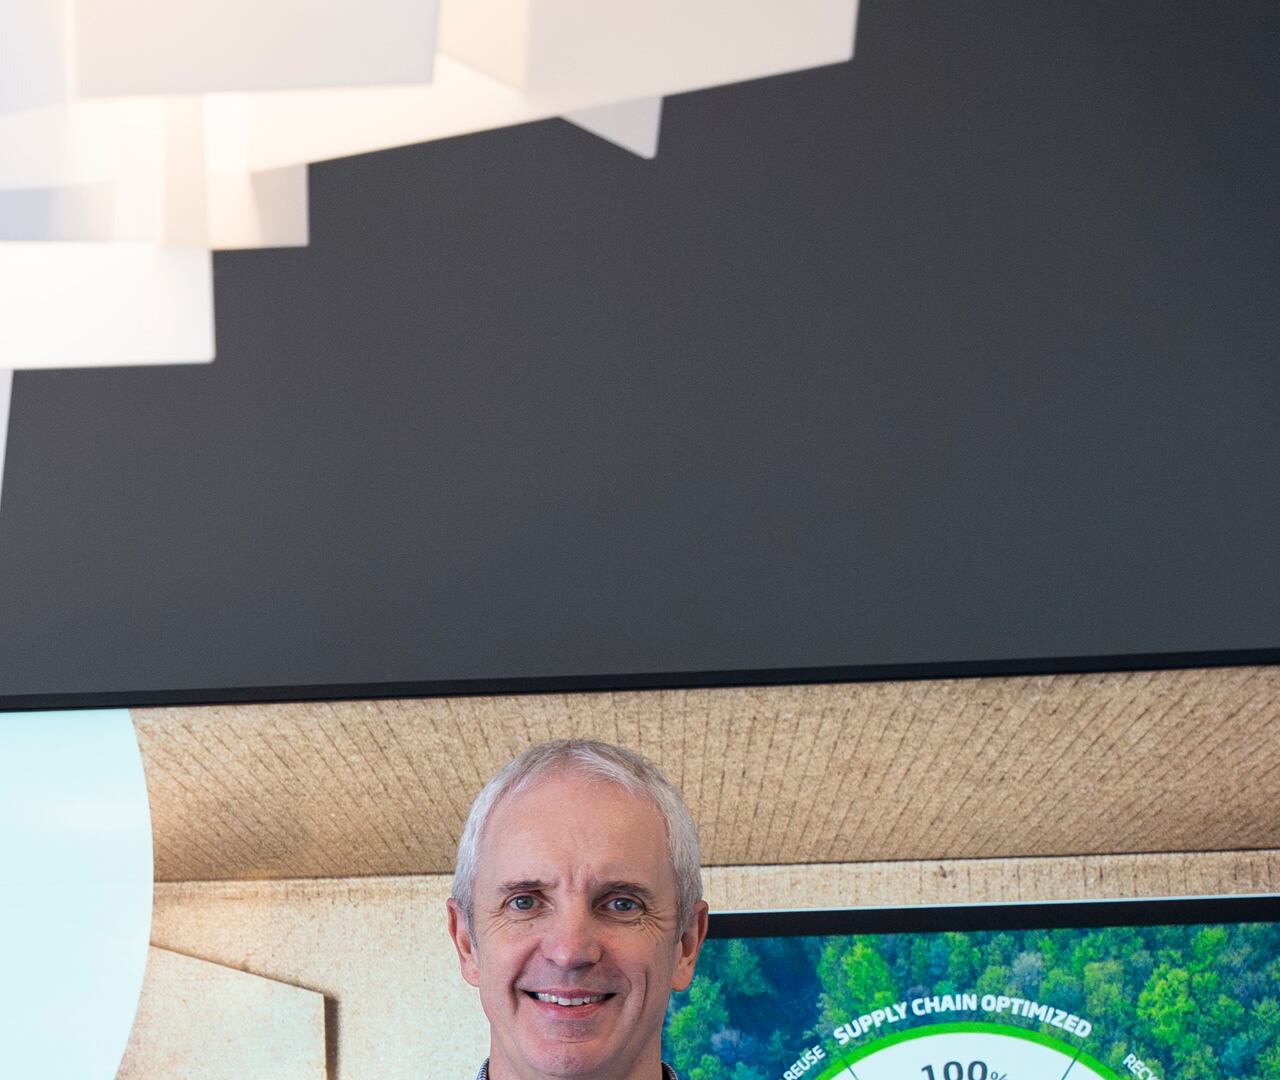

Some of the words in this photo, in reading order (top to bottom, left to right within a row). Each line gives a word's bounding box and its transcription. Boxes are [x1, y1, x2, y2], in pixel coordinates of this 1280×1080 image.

[833, 1002, 908, 1045] SUPPLY
[912, 994, 978, 1016] CHAIN
[981, 994, 1093, 1039] OPTIMIZED
